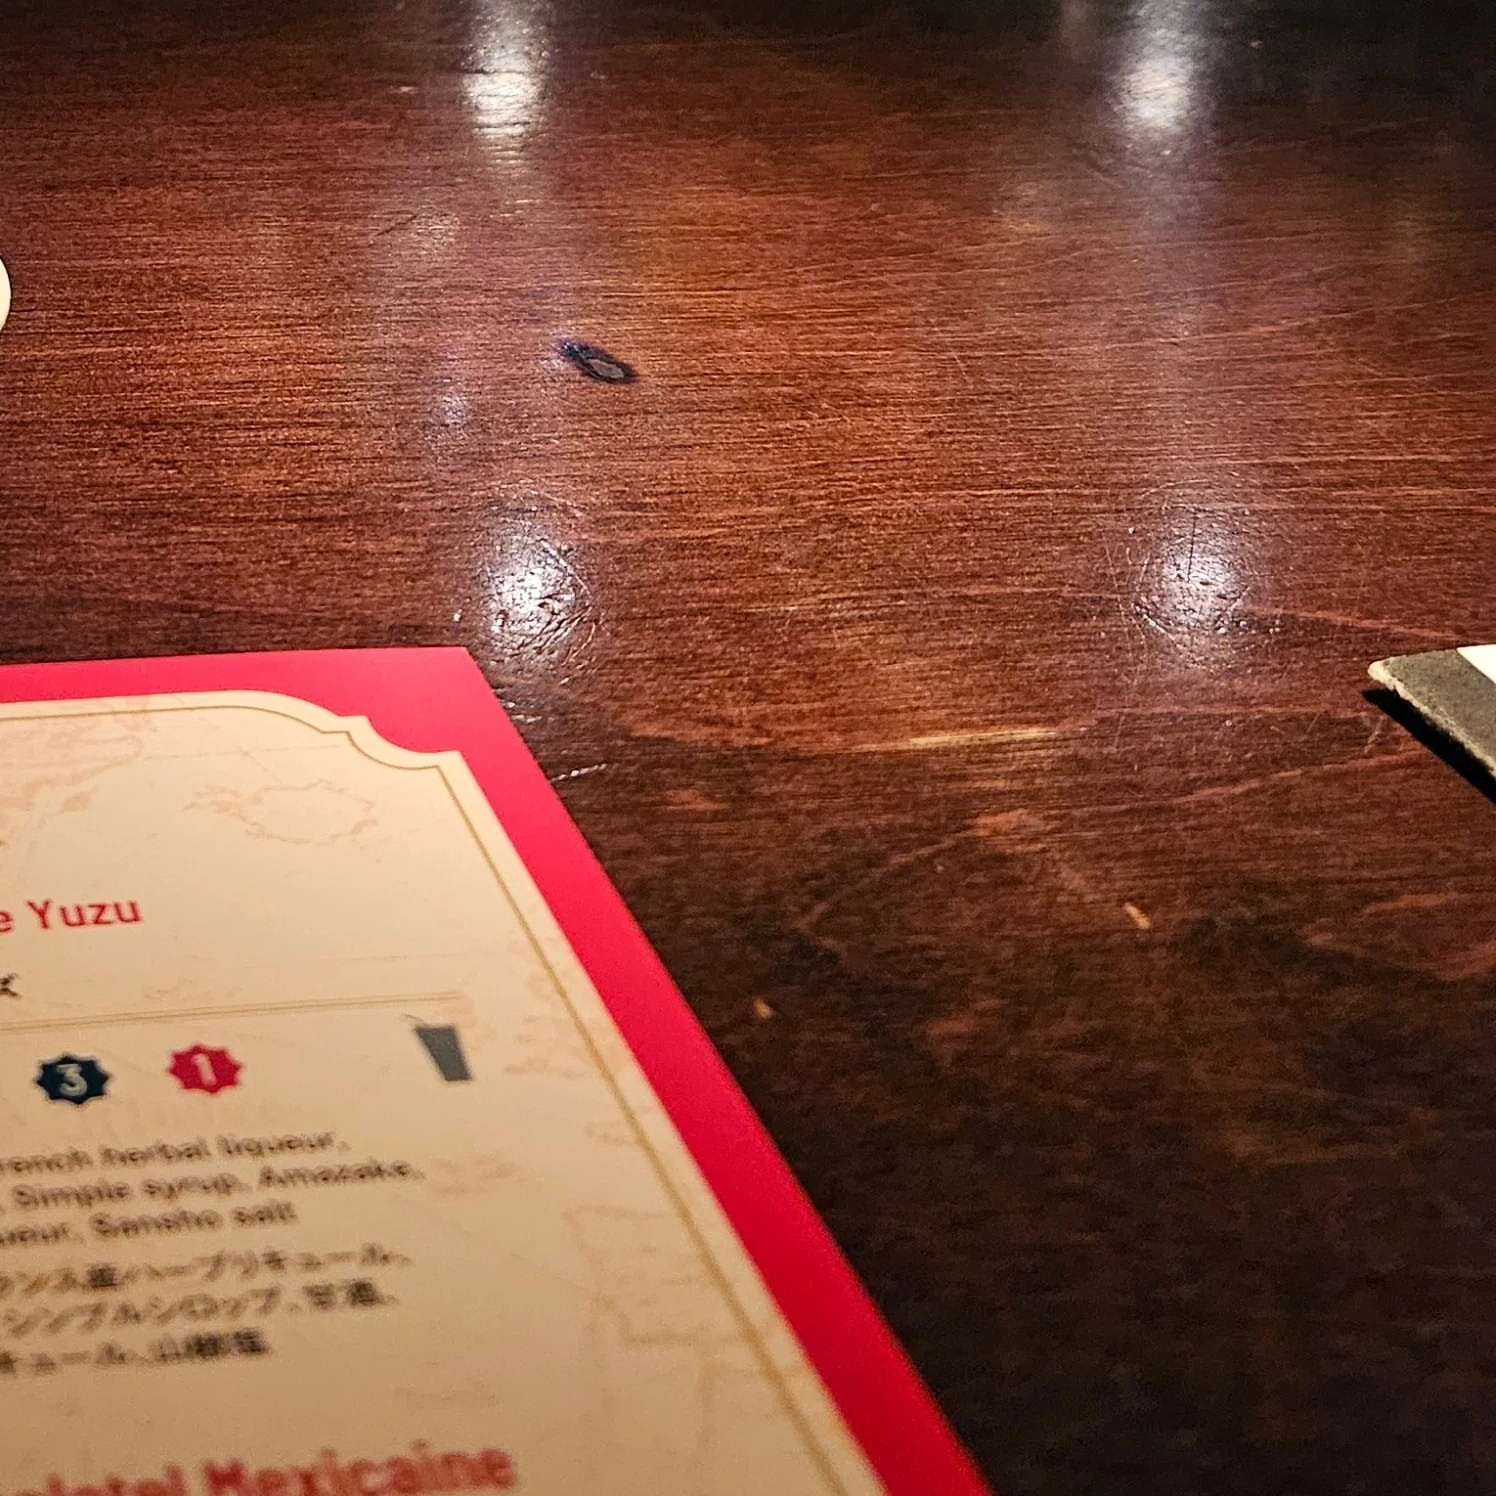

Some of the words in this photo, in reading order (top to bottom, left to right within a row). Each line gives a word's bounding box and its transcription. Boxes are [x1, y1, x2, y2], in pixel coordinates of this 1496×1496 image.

[26, 899, 142, 930] Yuzu
[57, 1063, 88, 1097] 3
[192, 1053, 217, 1086] 1
[12, 1183, 130, 1209] Simple
